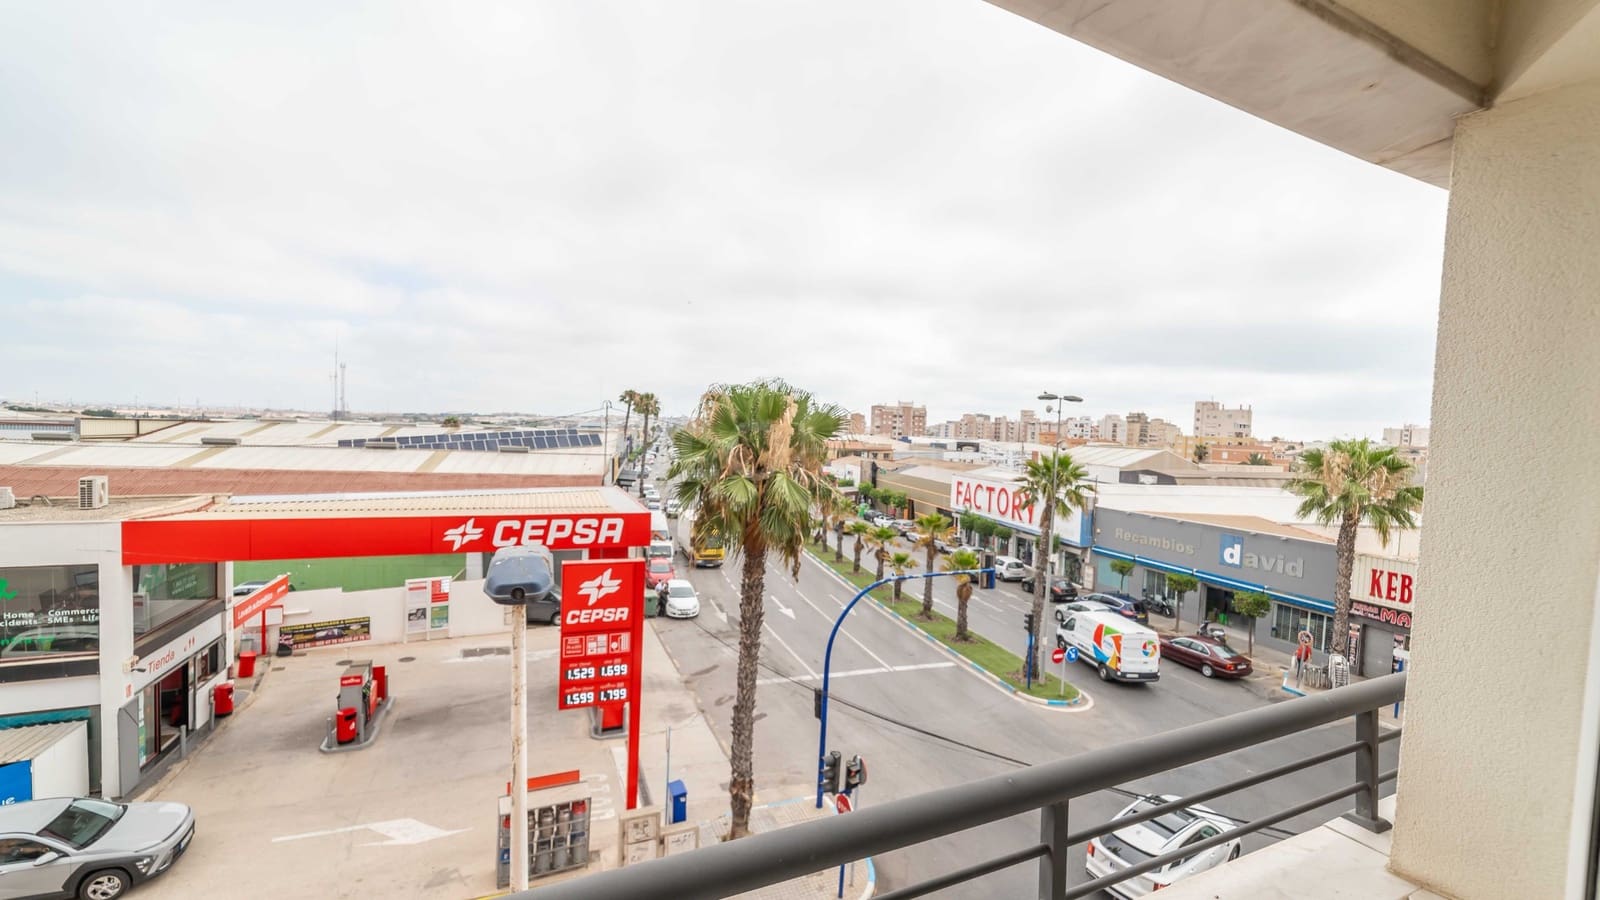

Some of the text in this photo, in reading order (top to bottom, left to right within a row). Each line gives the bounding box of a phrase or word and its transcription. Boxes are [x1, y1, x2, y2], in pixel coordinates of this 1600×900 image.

[956, 480, 1035, 524] FACTORY
[492, 518, 624, 547] CEPSA
[1115, 527, 1305, 579] Recambios david
[1369, 568, 1413, 604] KEB
[3, 611, 35, 619] Home
[47, 616, 74, 624] SMEs
[566, 607, 629, 625] CEPSA
[148, 649, 175, 674] Tienda
[567, 666, 595, 680] 1.529
[601, 664, 628, 677] 1.699
[566, 691, 595, 705] 1.599
[600, 688, 627, 702] 1.799
